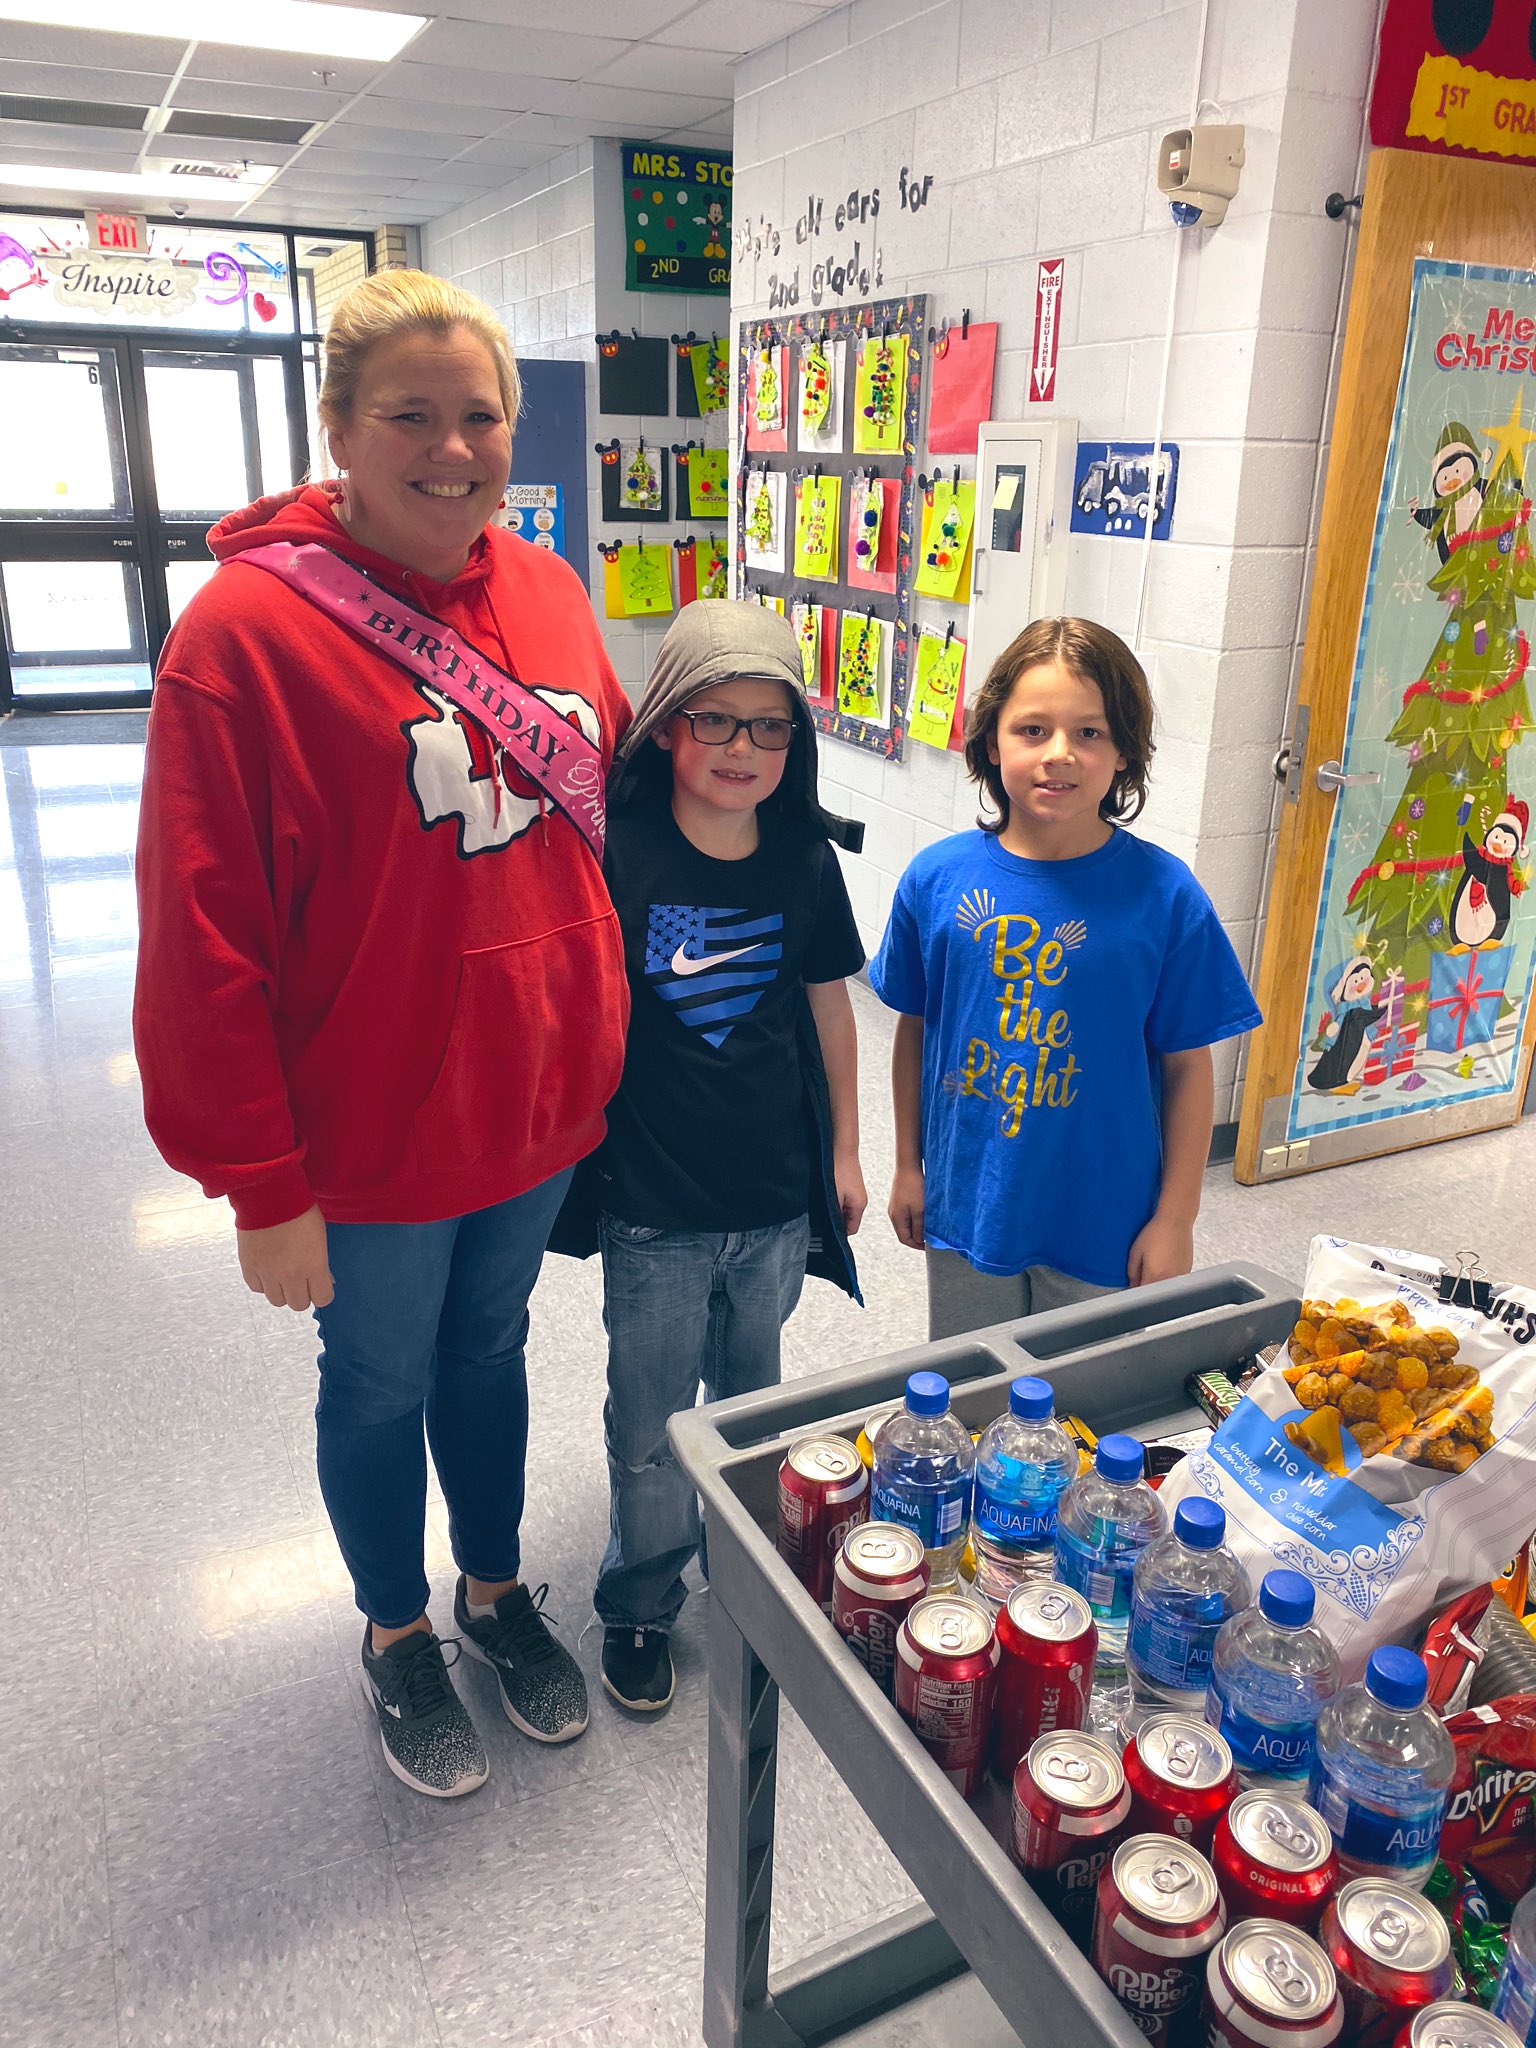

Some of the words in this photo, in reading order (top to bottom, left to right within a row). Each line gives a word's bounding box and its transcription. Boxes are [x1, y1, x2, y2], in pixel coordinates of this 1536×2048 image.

[1435, 84, 1470, 119] 1ST
[633, 152, 686, 178] MRS.
[795, 194, 824, 244] all
[835, 188, 880, 232] ears
[899, 167, 934, 213] for
[96, 213, 138, 248] EXIT
[62, 264, 174, 304] Inspire
[651, 258, 680, 278] 2ND
[1041, 276, 1060, 288] FIRE
[768, 264, 800, 310] 2nd
[1041, 289, 1052, 368] EXTINGUISHER
[88, 366, 98, 384] 6
[509, 495, 547, 507] Morning
[516, 486, 540, 496] Good
[362, 609, 569, 766] BIRTHDAY
[973, 914, 1067, 986] Be
[996, 979, 1072, 1049] the
[960, 1036, 1083, 1138] Light
[1213, 1442, 1247, 1475] caramel
[1245, 1474, 1265, 1494] corn
[1230, 1442, 1262, 1477] buttery
[1264, 1437, 1299, 1477] The
[873, 1485, 921, 1520] AQUAFINA
[981, 1499, 1057, 1532] AQUAFINA
[1304, 1522, 1326, 1541] corn
[952, 1698, 972, 1708] 150
[1252, 1735, 1314, 1761] AQUA
[1250, 1871, 1306, 1894] ORIGINAL
[1308, 1869, 1333, 1896] TASTE
[1109, 1964, 1194, 2009] Pepper
[1140, 1972, 1174, 1991] Dr
